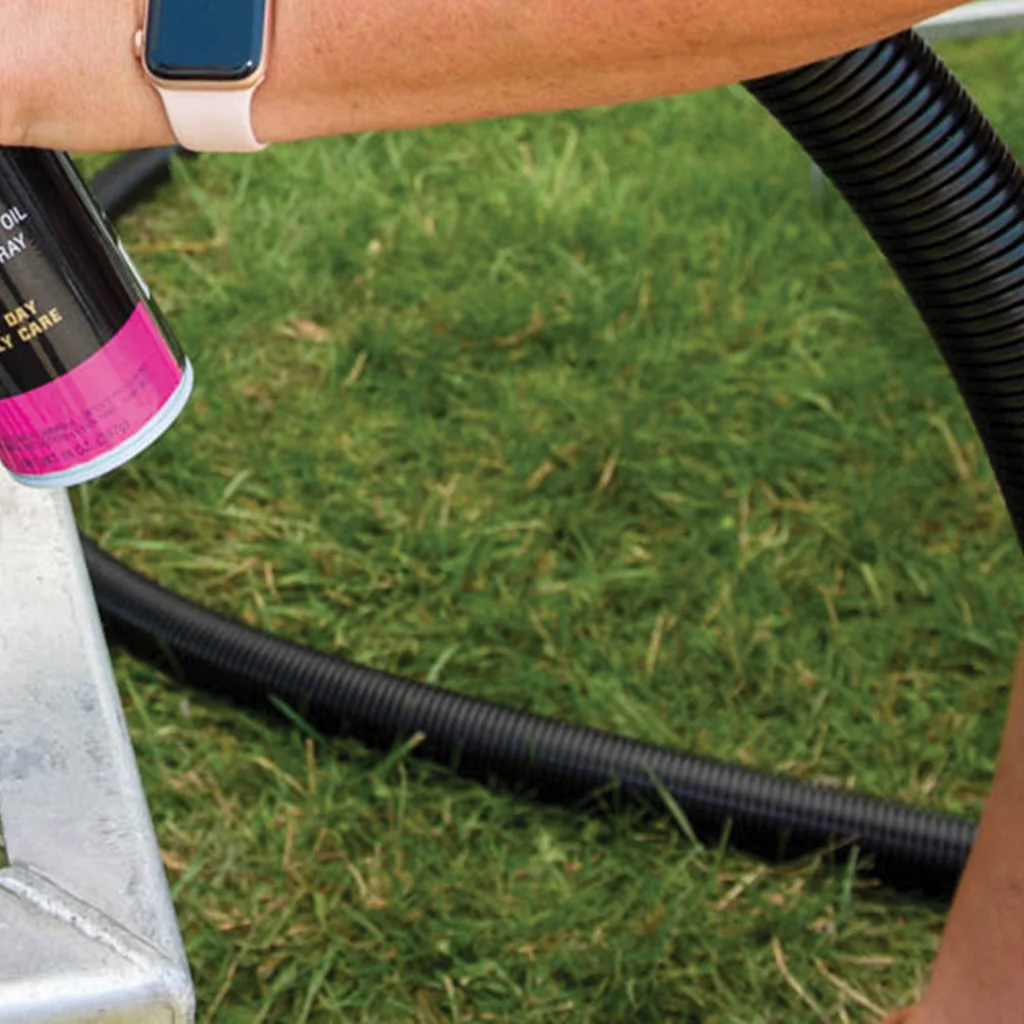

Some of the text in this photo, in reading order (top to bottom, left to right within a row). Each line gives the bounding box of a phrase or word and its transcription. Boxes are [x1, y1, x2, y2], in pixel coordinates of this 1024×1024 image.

[0, 206, 28, 230] OIL
[4, 299, 39, 326] DAY
[17, 307, 63, 342] CARE
